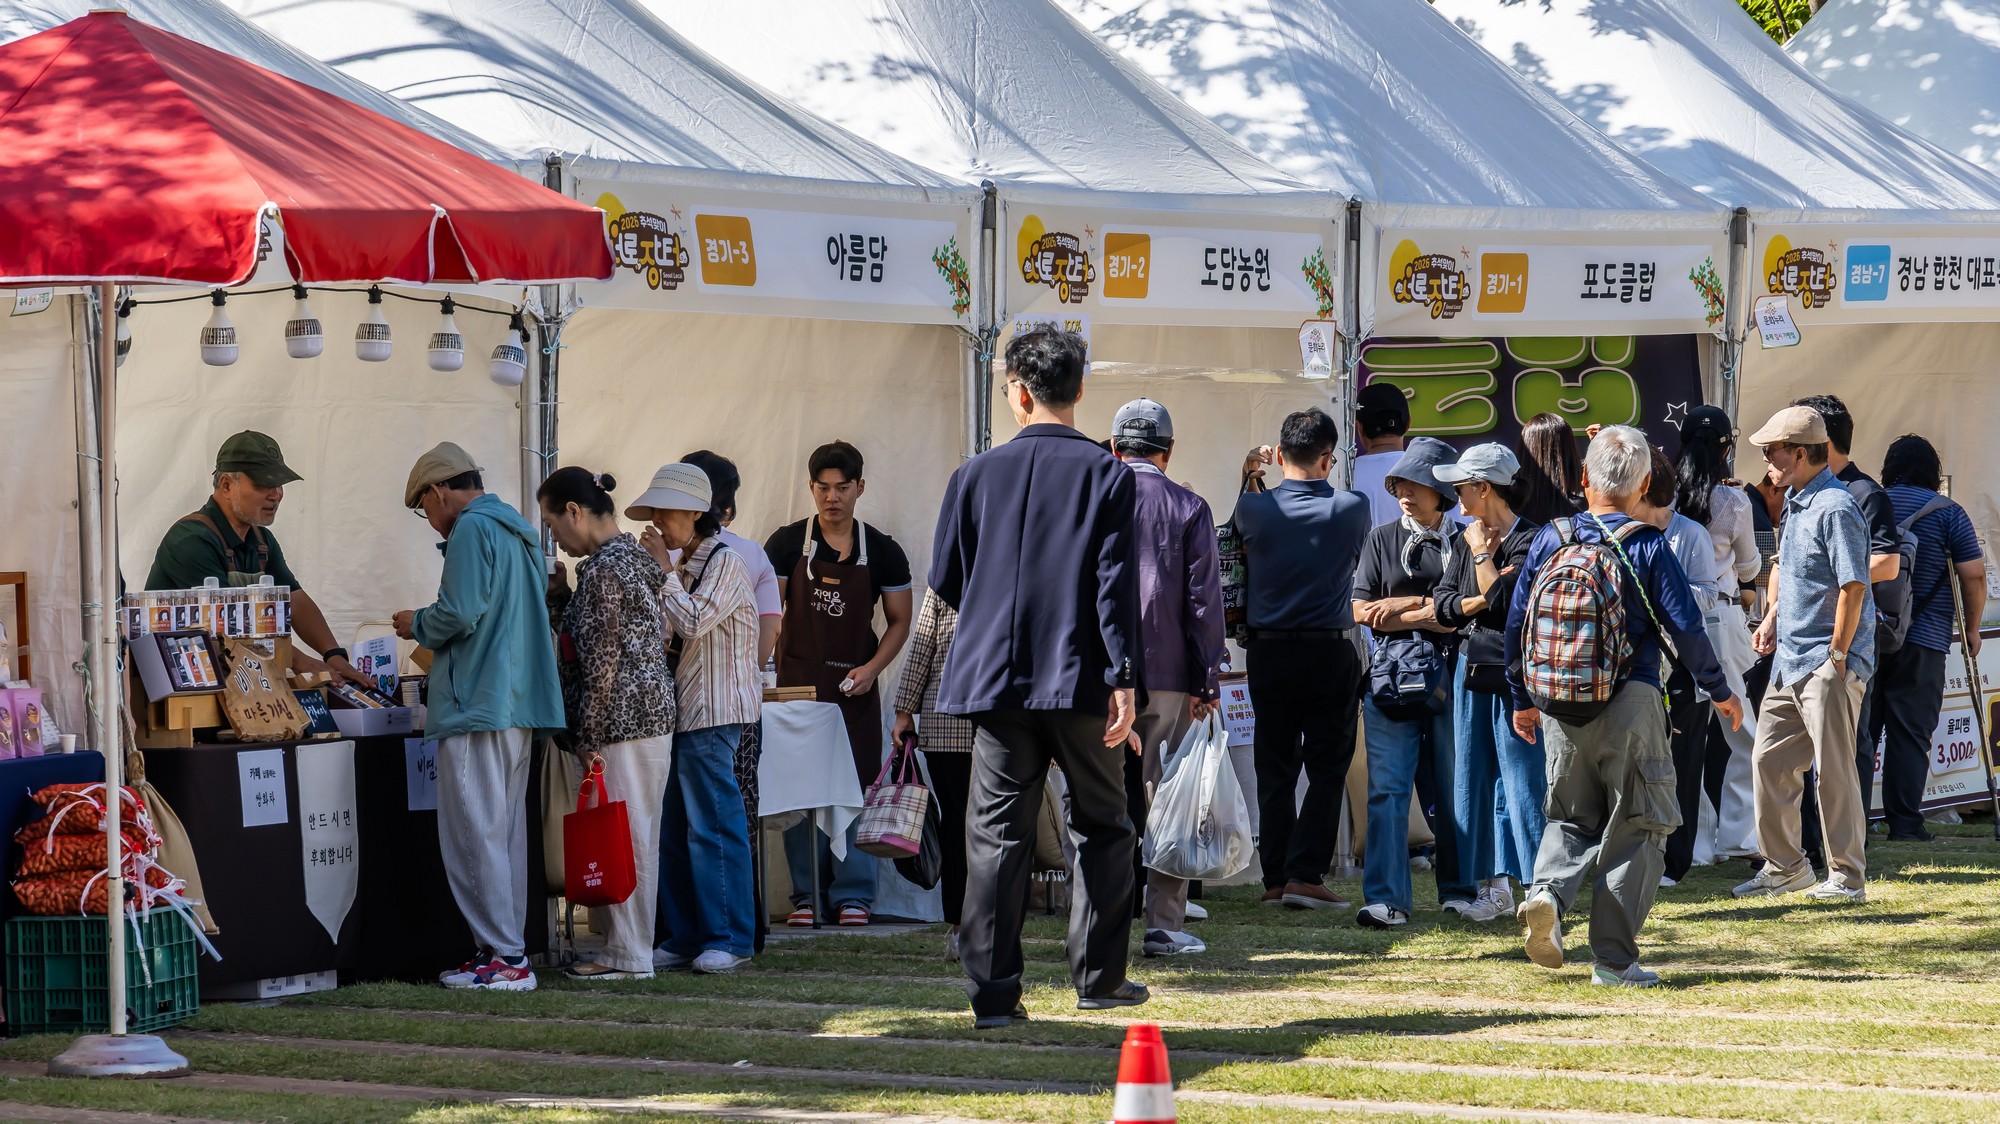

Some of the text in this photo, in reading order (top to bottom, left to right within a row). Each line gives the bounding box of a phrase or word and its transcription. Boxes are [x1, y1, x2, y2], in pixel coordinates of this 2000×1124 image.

[640, 214, 667, 235] 추석맞이
[704, 233, 888, 283] 경기-3 아름담
[1108, 247, 1271, 292] 경기-2 도담농원
[1486, 262, 1656, 304] 경기-1 포도클럽
[1850, 256, 2000, 292] 경남-7 경남 합천 대표
[243, 699, 295, 724] 마른기침
[249, 766, 261, 780] 카페
[1937, 781, 1967, 794] 담았습니다
[310, 845, 353, 867] 후회합니다
